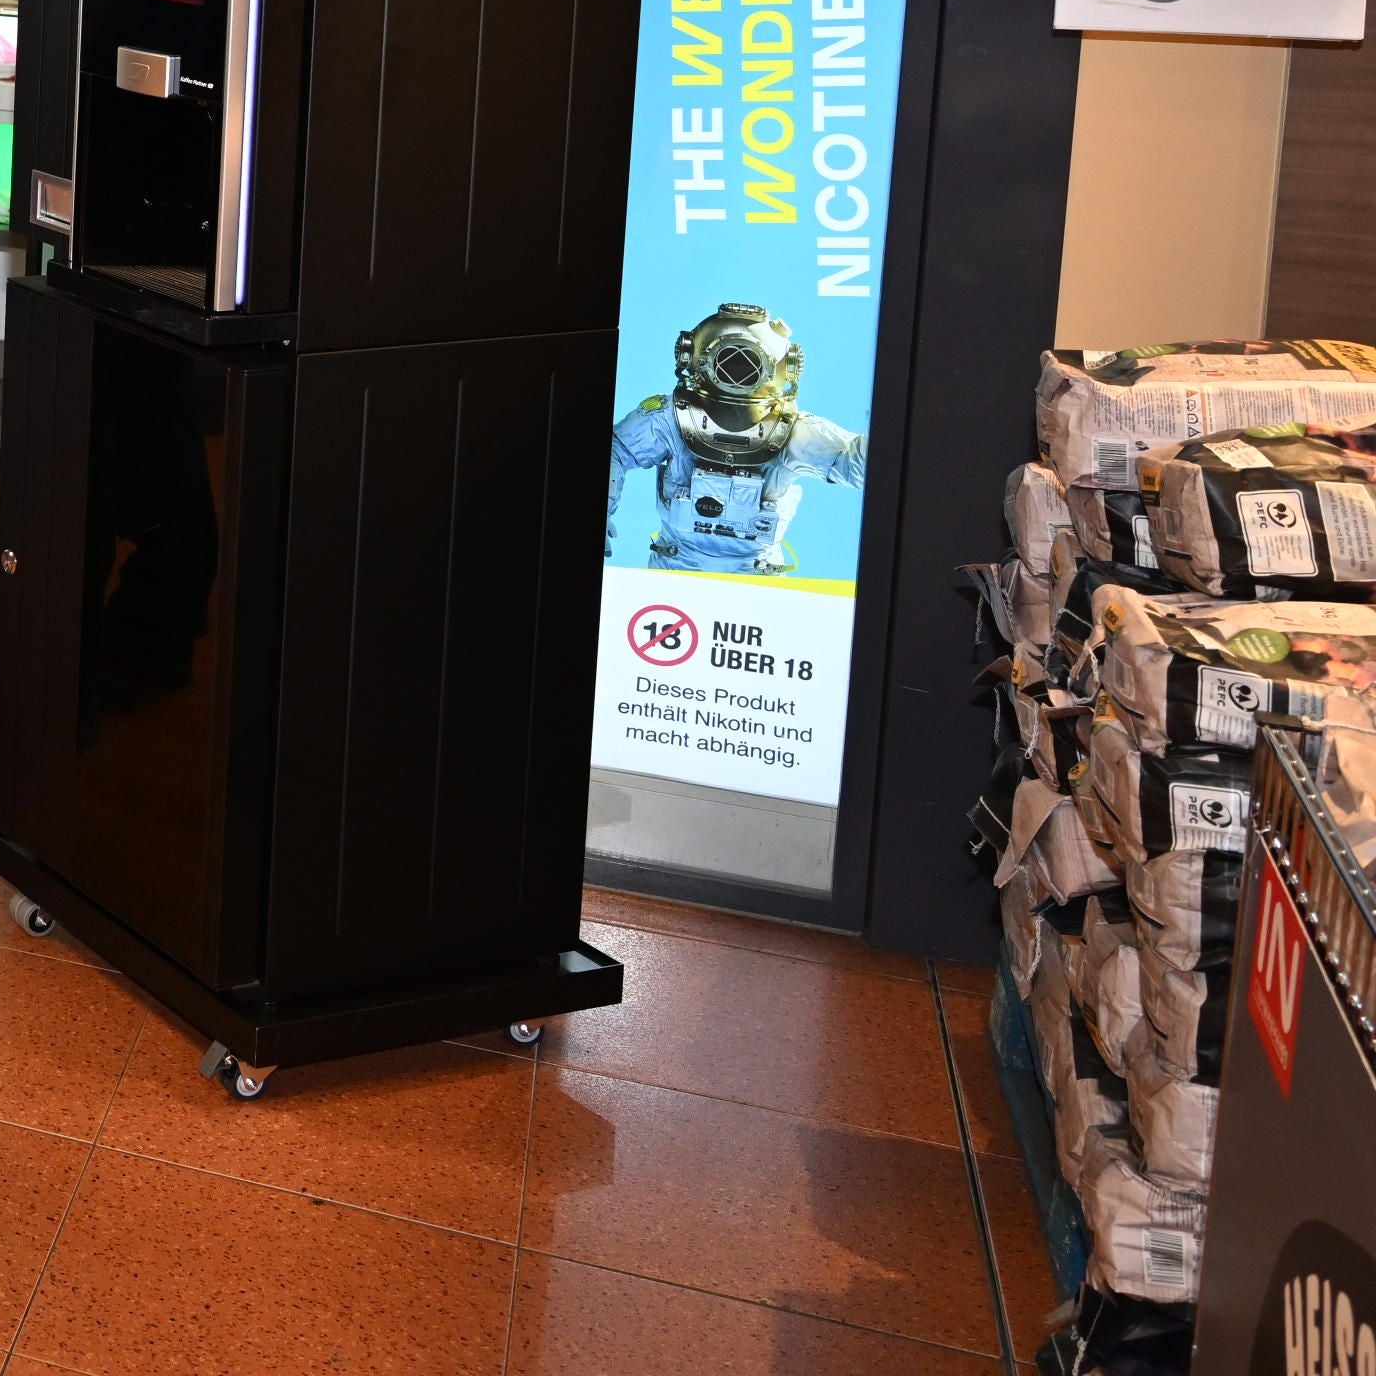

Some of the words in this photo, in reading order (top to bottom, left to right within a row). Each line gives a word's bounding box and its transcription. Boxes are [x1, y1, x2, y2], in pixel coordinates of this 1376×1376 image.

[672, 107, 728, 235] THE
[1254, 501, 1268, 530] PEFC
[643, 621, 682, 650] 18
[712, 620, 764, 647] NUR
[710, 643, 775, 676] ÜBER
[784, 658, 814, 681] 18
[635, 676, 707, 702] Dieses
[714, 687, 796, 716] Produkt
[1216, 678, 1226, 708] PEFC
[617, 701, 688, 724] enthält
[695, 709, 766, 736] Nikotin
[773, 726, 813, 743] und
[625, 726, 690, 748] macht
[696, 736, 800, 769] abhängig.
[1187, 795, 1198, 825] PEFC
